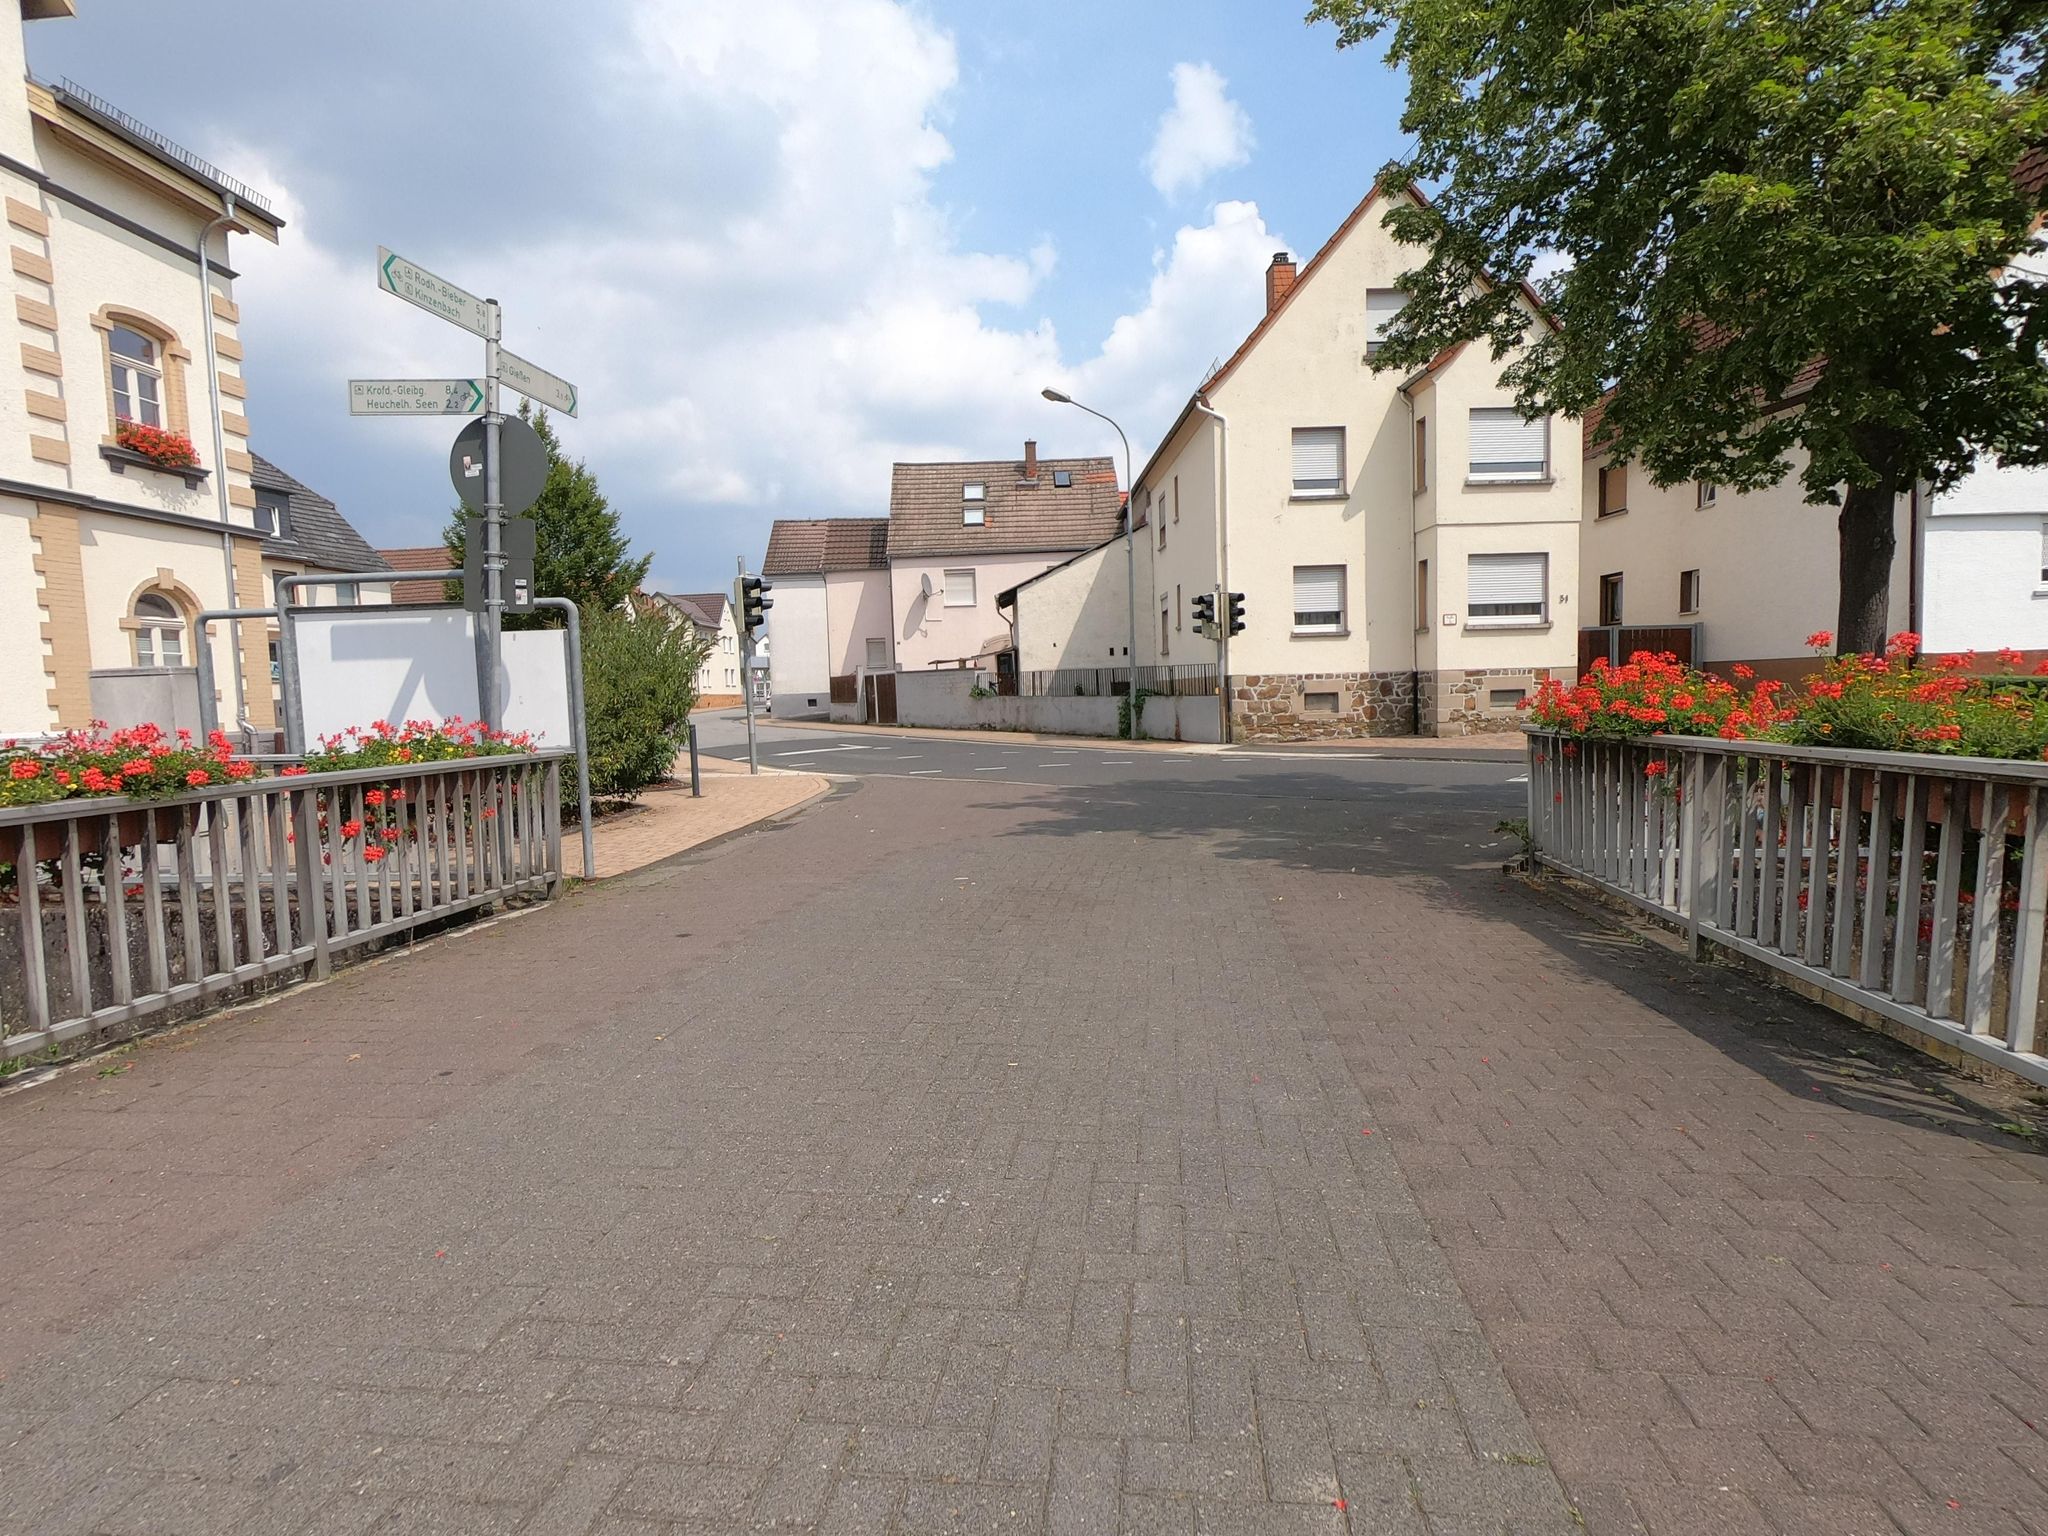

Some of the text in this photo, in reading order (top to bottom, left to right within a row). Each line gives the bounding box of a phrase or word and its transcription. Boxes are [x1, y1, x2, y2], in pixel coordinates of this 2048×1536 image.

[414, 271, 467, 307] Rodh.-Bieber
[414, 287, 461, 320] Kinzenbach
[366, 399, 412, 409] Heuchelh.
[415, 399, 439, 409] Seen
